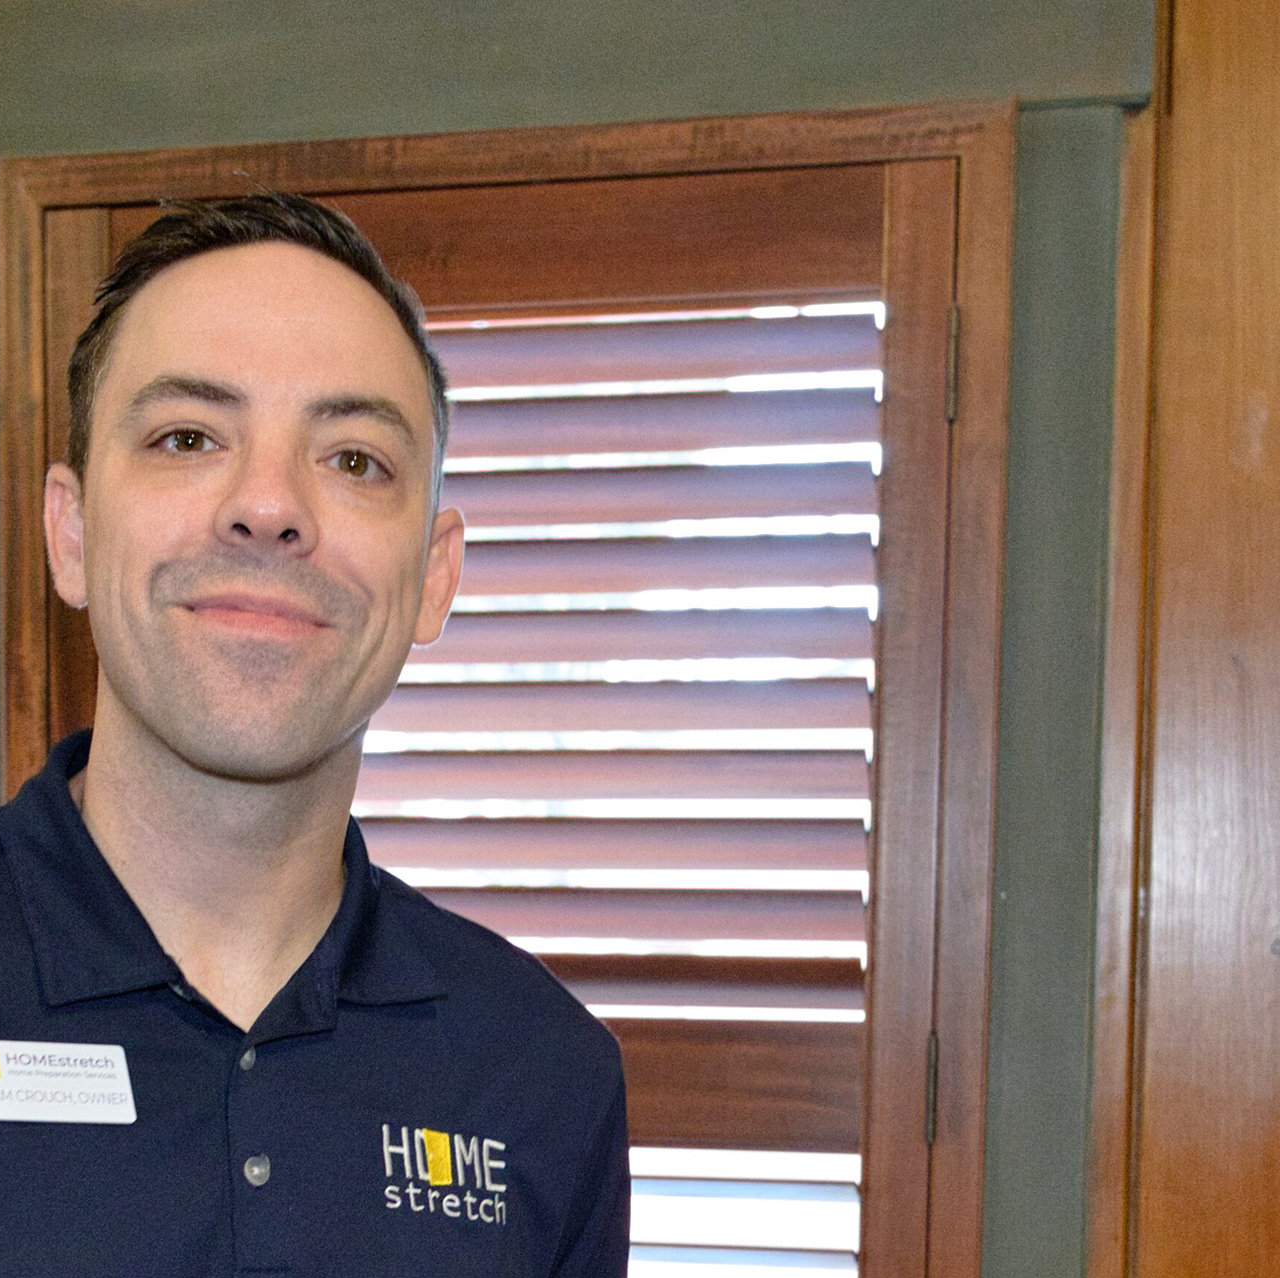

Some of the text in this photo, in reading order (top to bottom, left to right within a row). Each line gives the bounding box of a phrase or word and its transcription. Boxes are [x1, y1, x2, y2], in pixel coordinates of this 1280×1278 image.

[6, 1053, 115, 1069] HOMEstretch
[78, 1091, 128, 1105] OWNER
[384, 1181, 507, 1226] stretch
